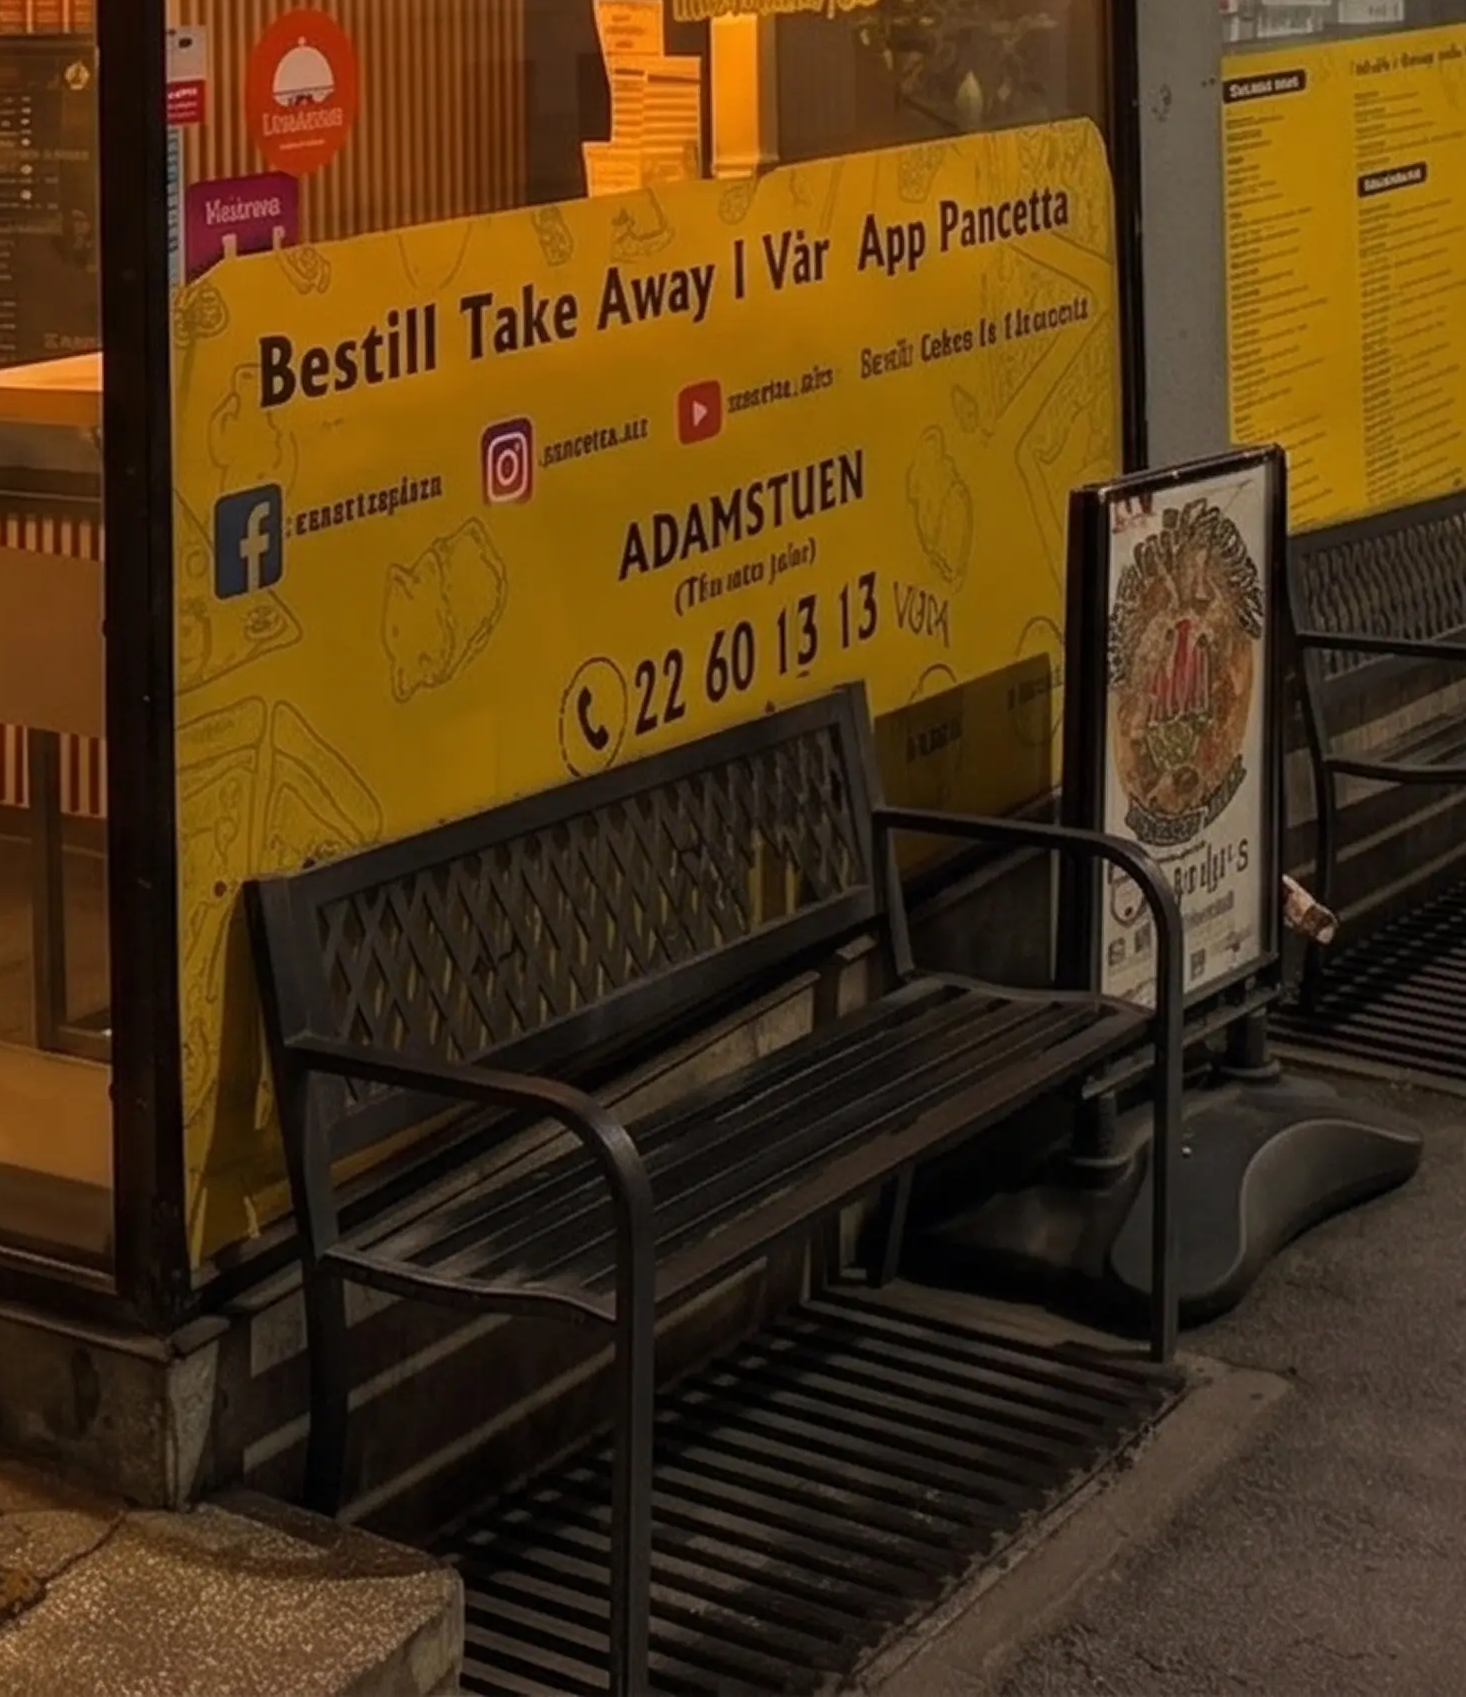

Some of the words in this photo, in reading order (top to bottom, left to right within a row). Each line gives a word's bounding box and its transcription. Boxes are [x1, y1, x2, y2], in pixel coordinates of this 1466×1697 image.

[258, 304, 437, 408] Bestill
[460, 284, 578, 360] Take
[597, 267, 715, 324] Away
[762, 229, 831, 291] Vår
[857, 213, 927, 277] App
[939, 187, 1069, 253] Pancetta
[618, 449, 864, 581] ADAMSTUEN
[635, 648, 687, 736] 22
[706, 620, 756, 703] 60
[777, 593, 818, 676] 13
[838, 570, 877, 649] 13
